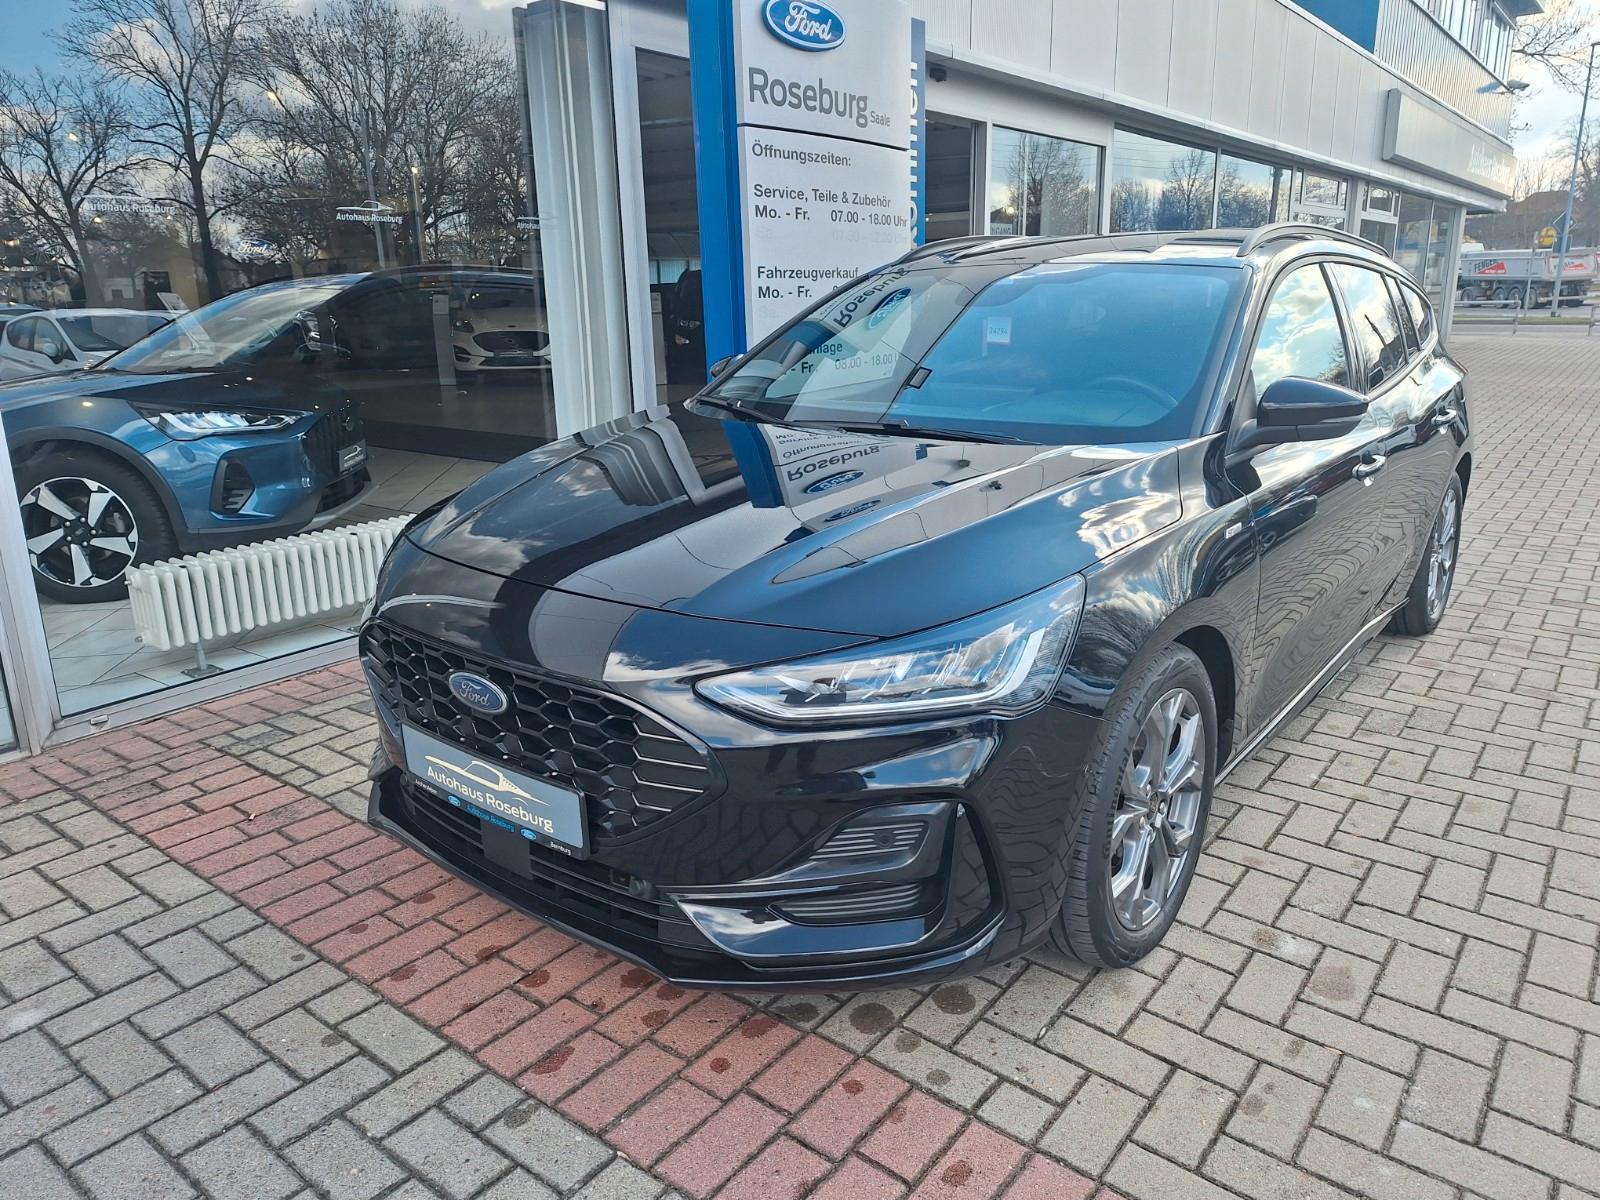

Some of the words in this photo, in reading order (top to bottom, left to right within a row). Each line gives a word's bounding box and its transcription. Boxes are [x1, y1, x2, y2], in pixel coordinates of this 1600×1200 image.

[785, 2, 834, 41] Ford
[748, 67, 869, 129] Roseburg
[870, 111, 891, 127] Saale
[752, 139, 852, 167] Öffnungszeiten:
[753, 183, 808, 203] Service,
[812, 188, 839, 203] Teile
[841, 191, 849, 204] &
[852, 192, 892, 208] Zubehör
[336, 212, 371, 222] Autohaus
[754, 205, 781, 219] Mo.
[795, 207, 811, 221] Fr.
[831, 209, 859, 224] 07.00
[868, 213, 892, 226] 18.00
[893, 215, 908, 228] Uhr
[757, 265, 860, 282] Fahrzeugverkauf
[758, 285, 784, 299] Mo.
[797, 285, 813, 298] Fr.
[459, 680, 490, 706] Ford
[427, 765, 484, 802] Autohaus
[485, 792, 554, 834] Roseburg
